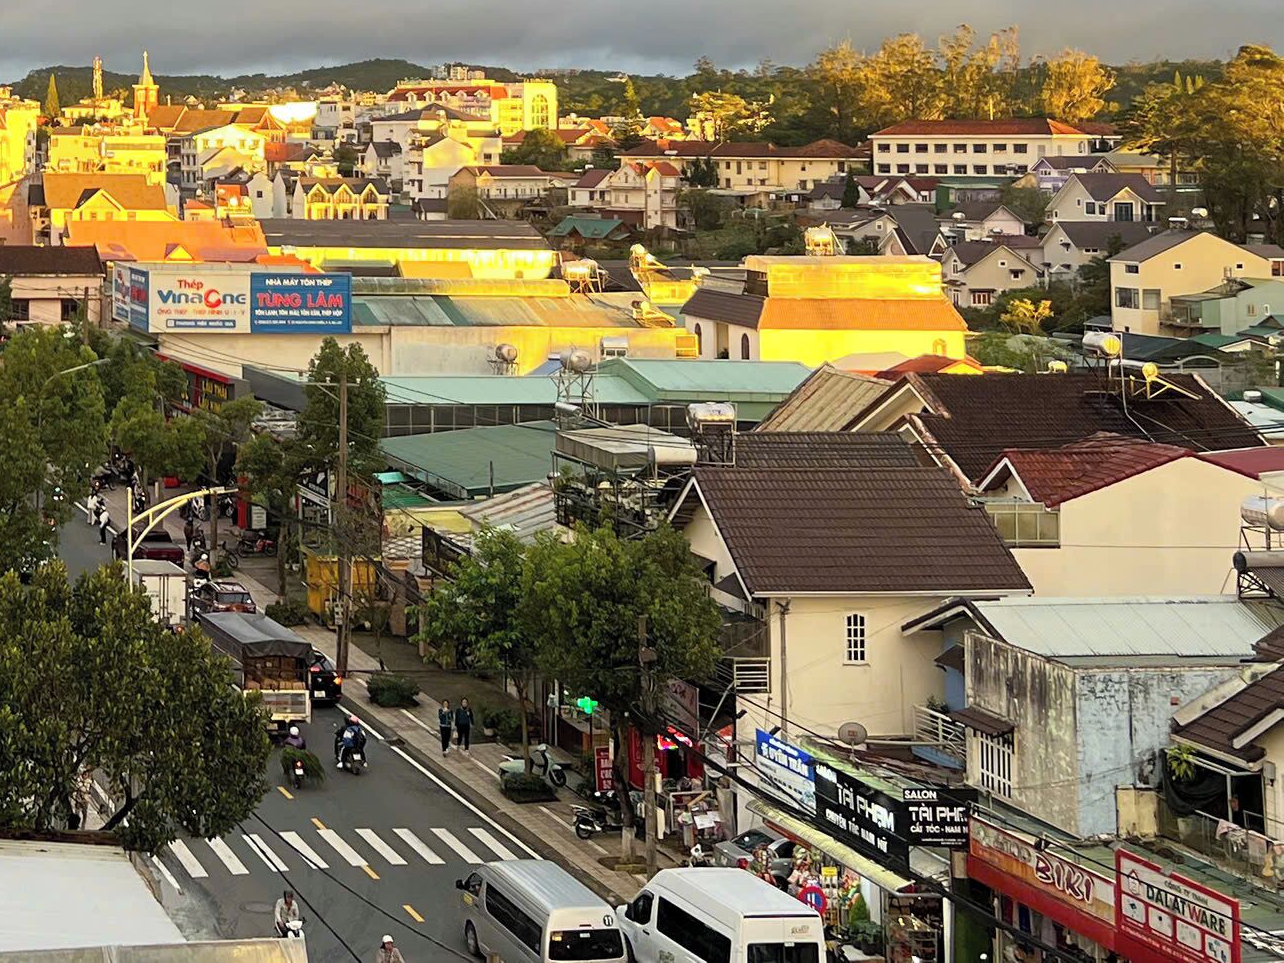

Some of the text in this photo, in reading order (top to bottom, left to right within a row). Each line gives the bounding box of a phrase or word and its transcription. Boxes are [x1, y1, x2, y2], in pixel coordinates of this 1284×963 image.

[177, 279, 204, 290] Thép
[257, 290, 343, 308] TÙNG LÂM
[904, 790, 937, 799] SALON
[837, 783, 855, 810] TÀI
[856, 795, 895, 832] PHẠM
[908, 802, 968, 822] TÀI PH
[925, 823, 940, 833] TÓC
[944, 825, 961, 833] NAM
[1035, 852, 1094, 904] BIKI
[1146, 884, 1226, 936] DALATWARE
[604, 916, 612, 926] 11
